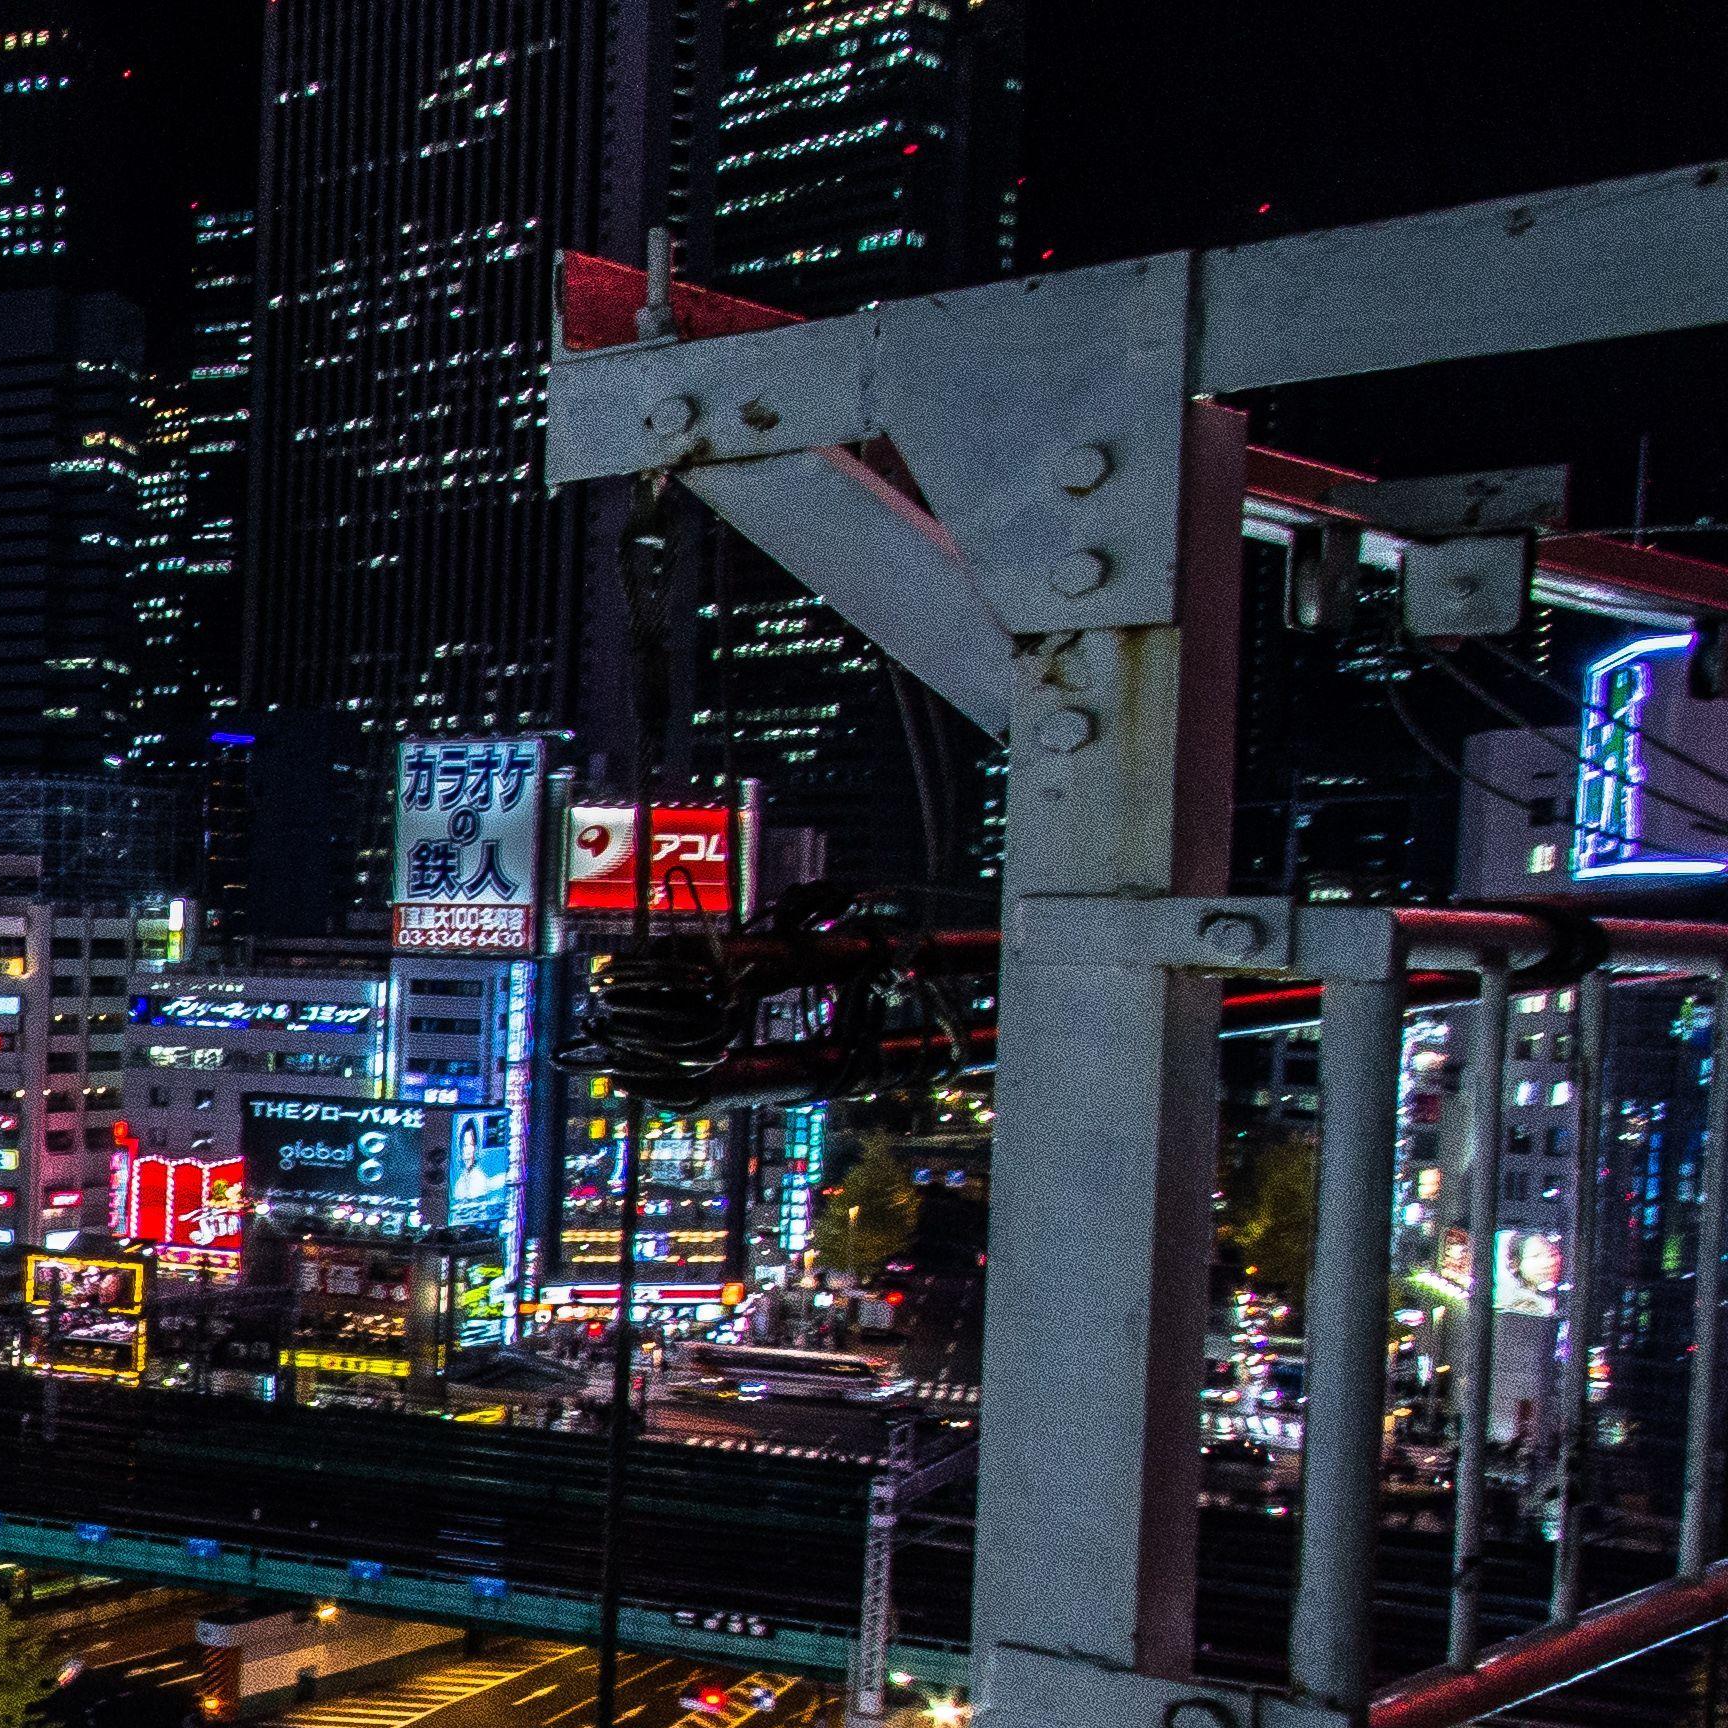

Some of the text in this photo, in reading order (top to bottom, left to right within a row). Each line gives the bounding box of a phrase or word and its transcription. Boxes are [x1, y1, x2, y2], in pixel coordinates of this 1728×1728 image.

[406, 750, 535, 809] カラオケ
[451, 811, 478, 843] の
[412, 842, 517, 897] 鉄人
[251, 1100, 425, 1128] THEグローバル社
[280, 1141, 354, 1170] global
